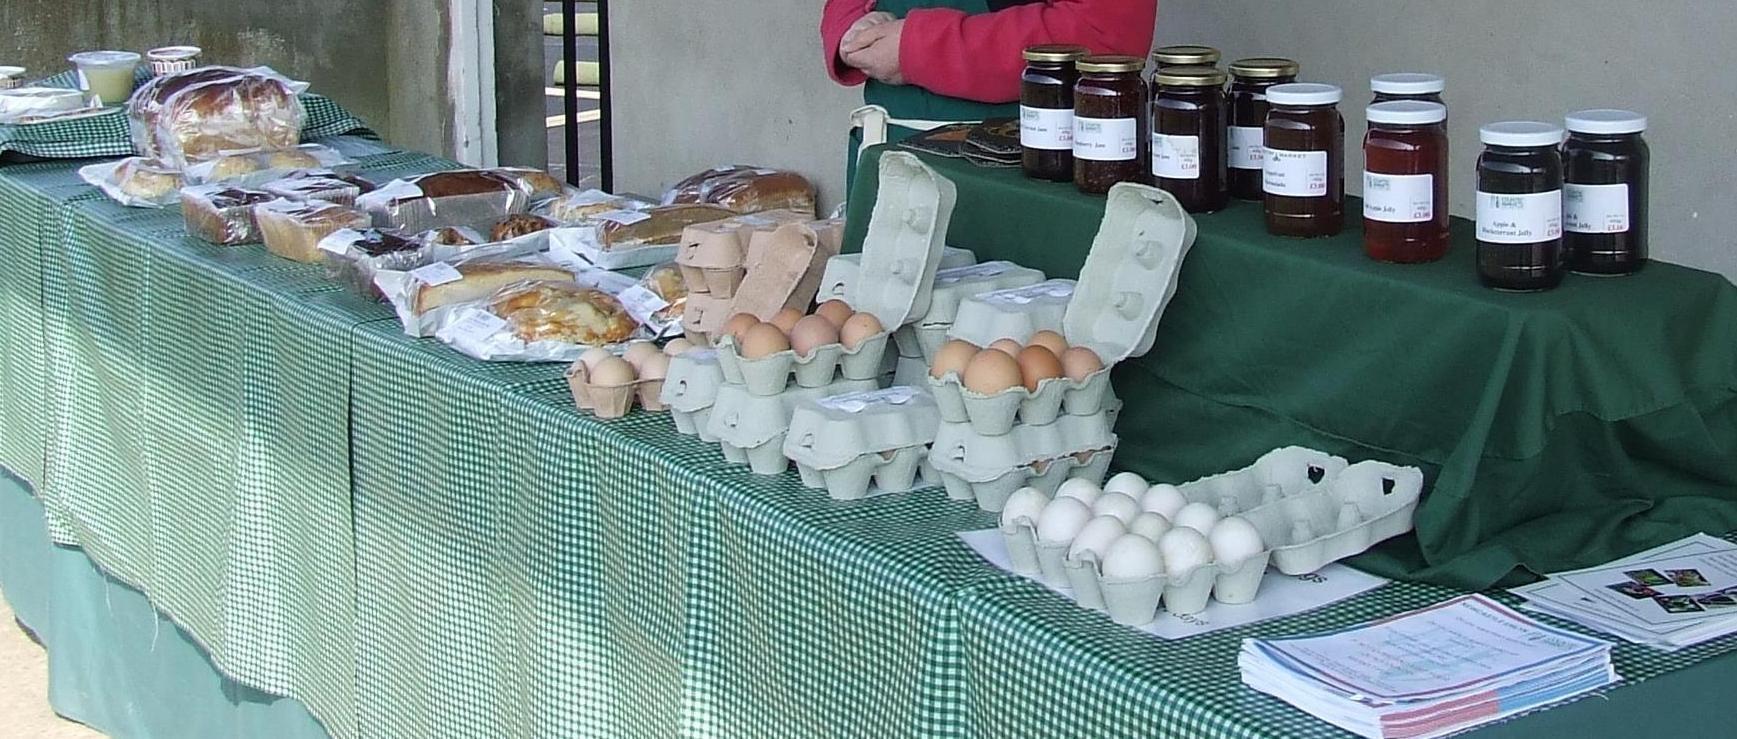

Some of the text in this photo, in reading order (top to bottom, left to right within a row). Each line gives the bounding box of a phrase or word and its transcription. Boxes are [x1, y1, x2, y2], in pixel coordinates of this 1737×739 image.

[1492, 220, 1509, 229] Apple
[1481, 227, 1533, 238] Blackcurrant Jelly
